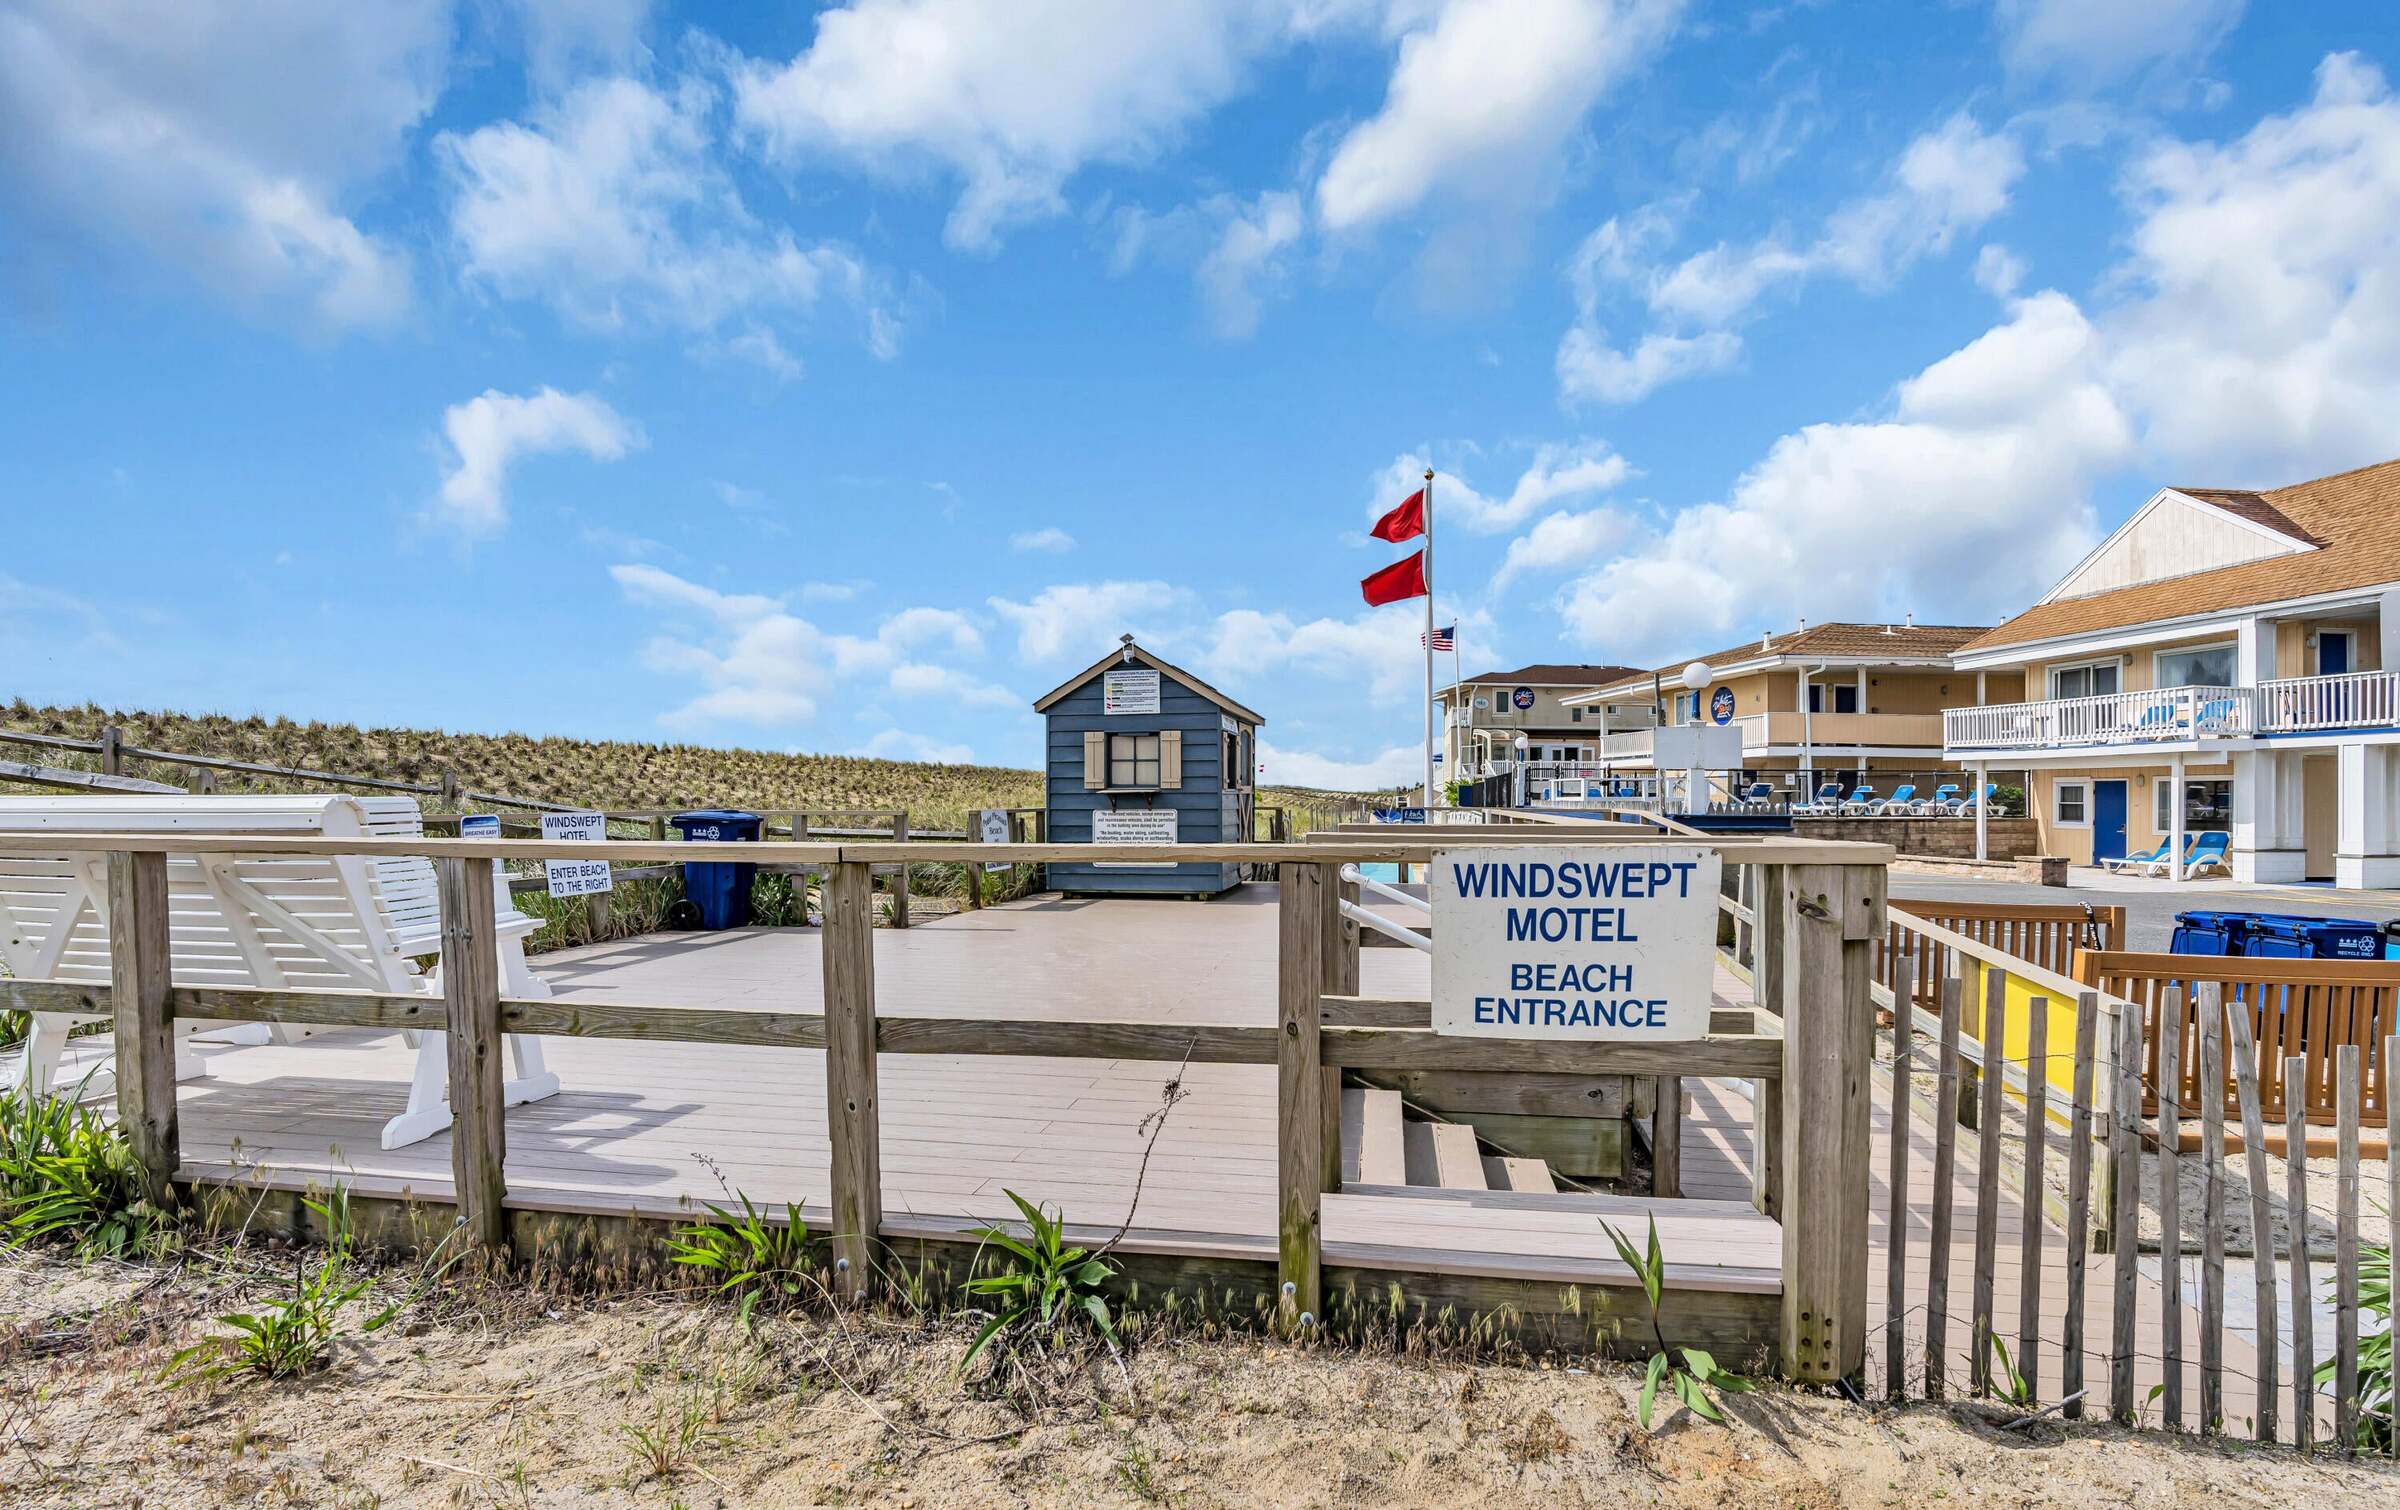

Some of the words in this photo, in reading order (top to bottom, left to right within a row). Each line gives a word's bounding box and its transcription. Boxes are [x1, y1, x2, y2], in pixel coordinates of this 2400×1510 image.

[545, 816, 602, 828] WINDSWEPT
[560, 830, 590, 840] HOTEL
[551, 866, 578, 880] ENTER
[580, 864, 606, 877] BEACH
[1453, 862, 1697, 898] WINDSWEPT
[553, 882, 564, 894] TO
[567, 880, 582, 892] THE
[585, 878, 608, 890] RIGHT
[1506, 907, 1638, 942] MOTEL
[1511, 964, 1633, 993] BEACH
[1474, 997, 1668, 1028] ENTRANCE
